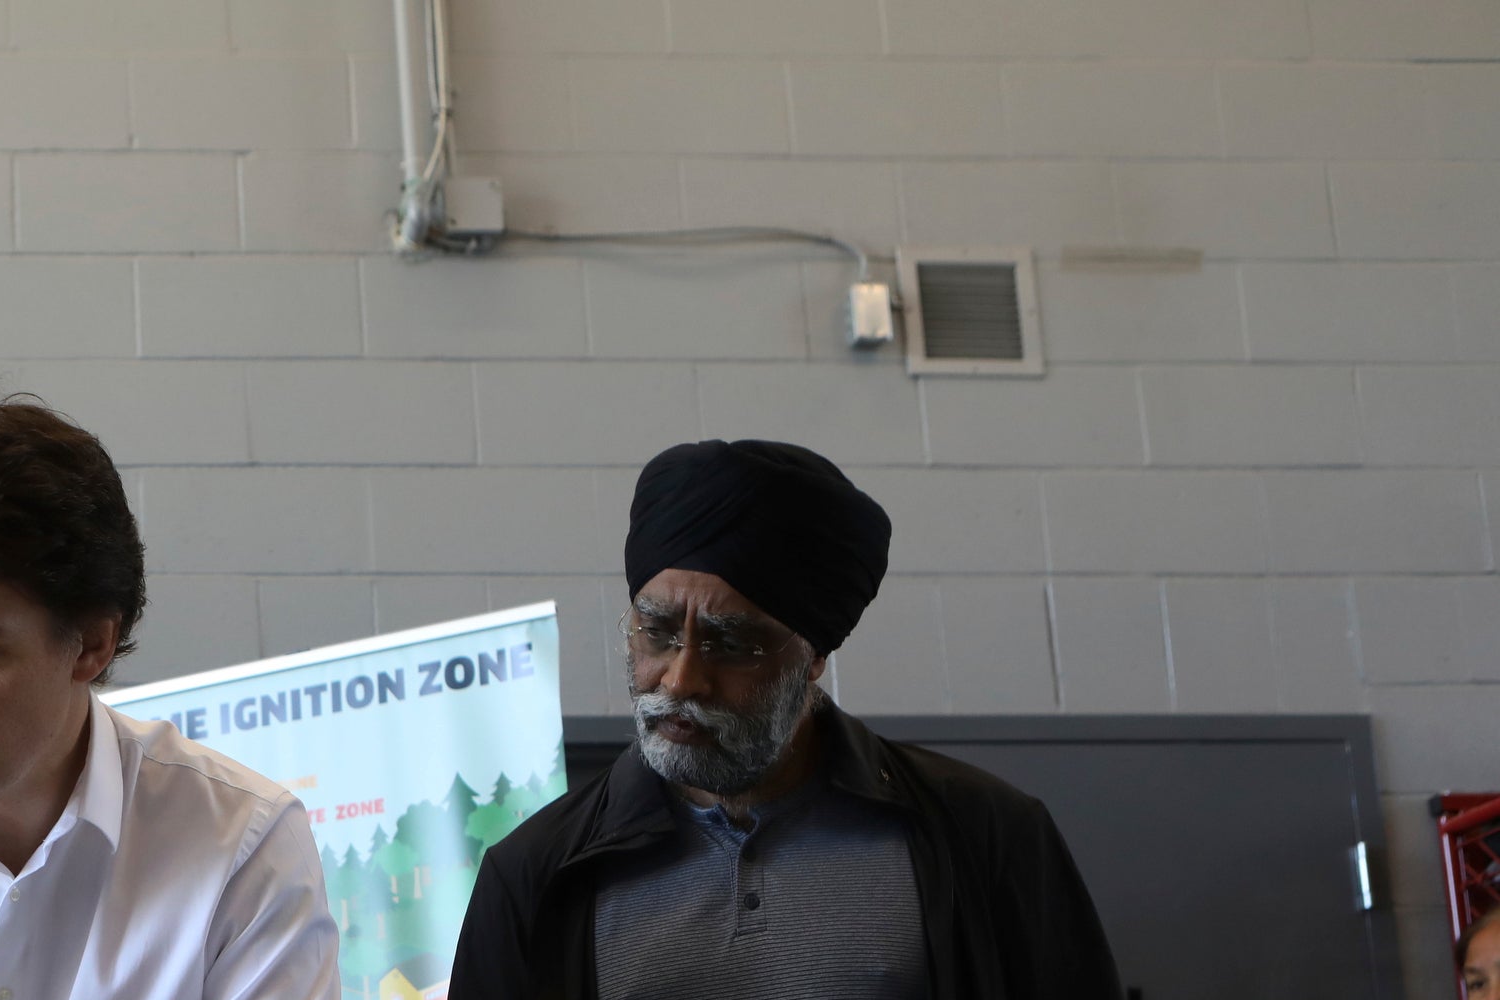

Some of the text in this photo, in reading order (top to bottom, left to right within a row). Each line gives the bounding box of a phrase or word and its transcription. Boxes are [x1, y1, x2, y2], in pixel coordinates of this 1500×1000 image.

[220, 668, 405, 735] IGNITION
[418, 642, 535, 698] ZONE
[336, 797, 385, 820] ZONE
